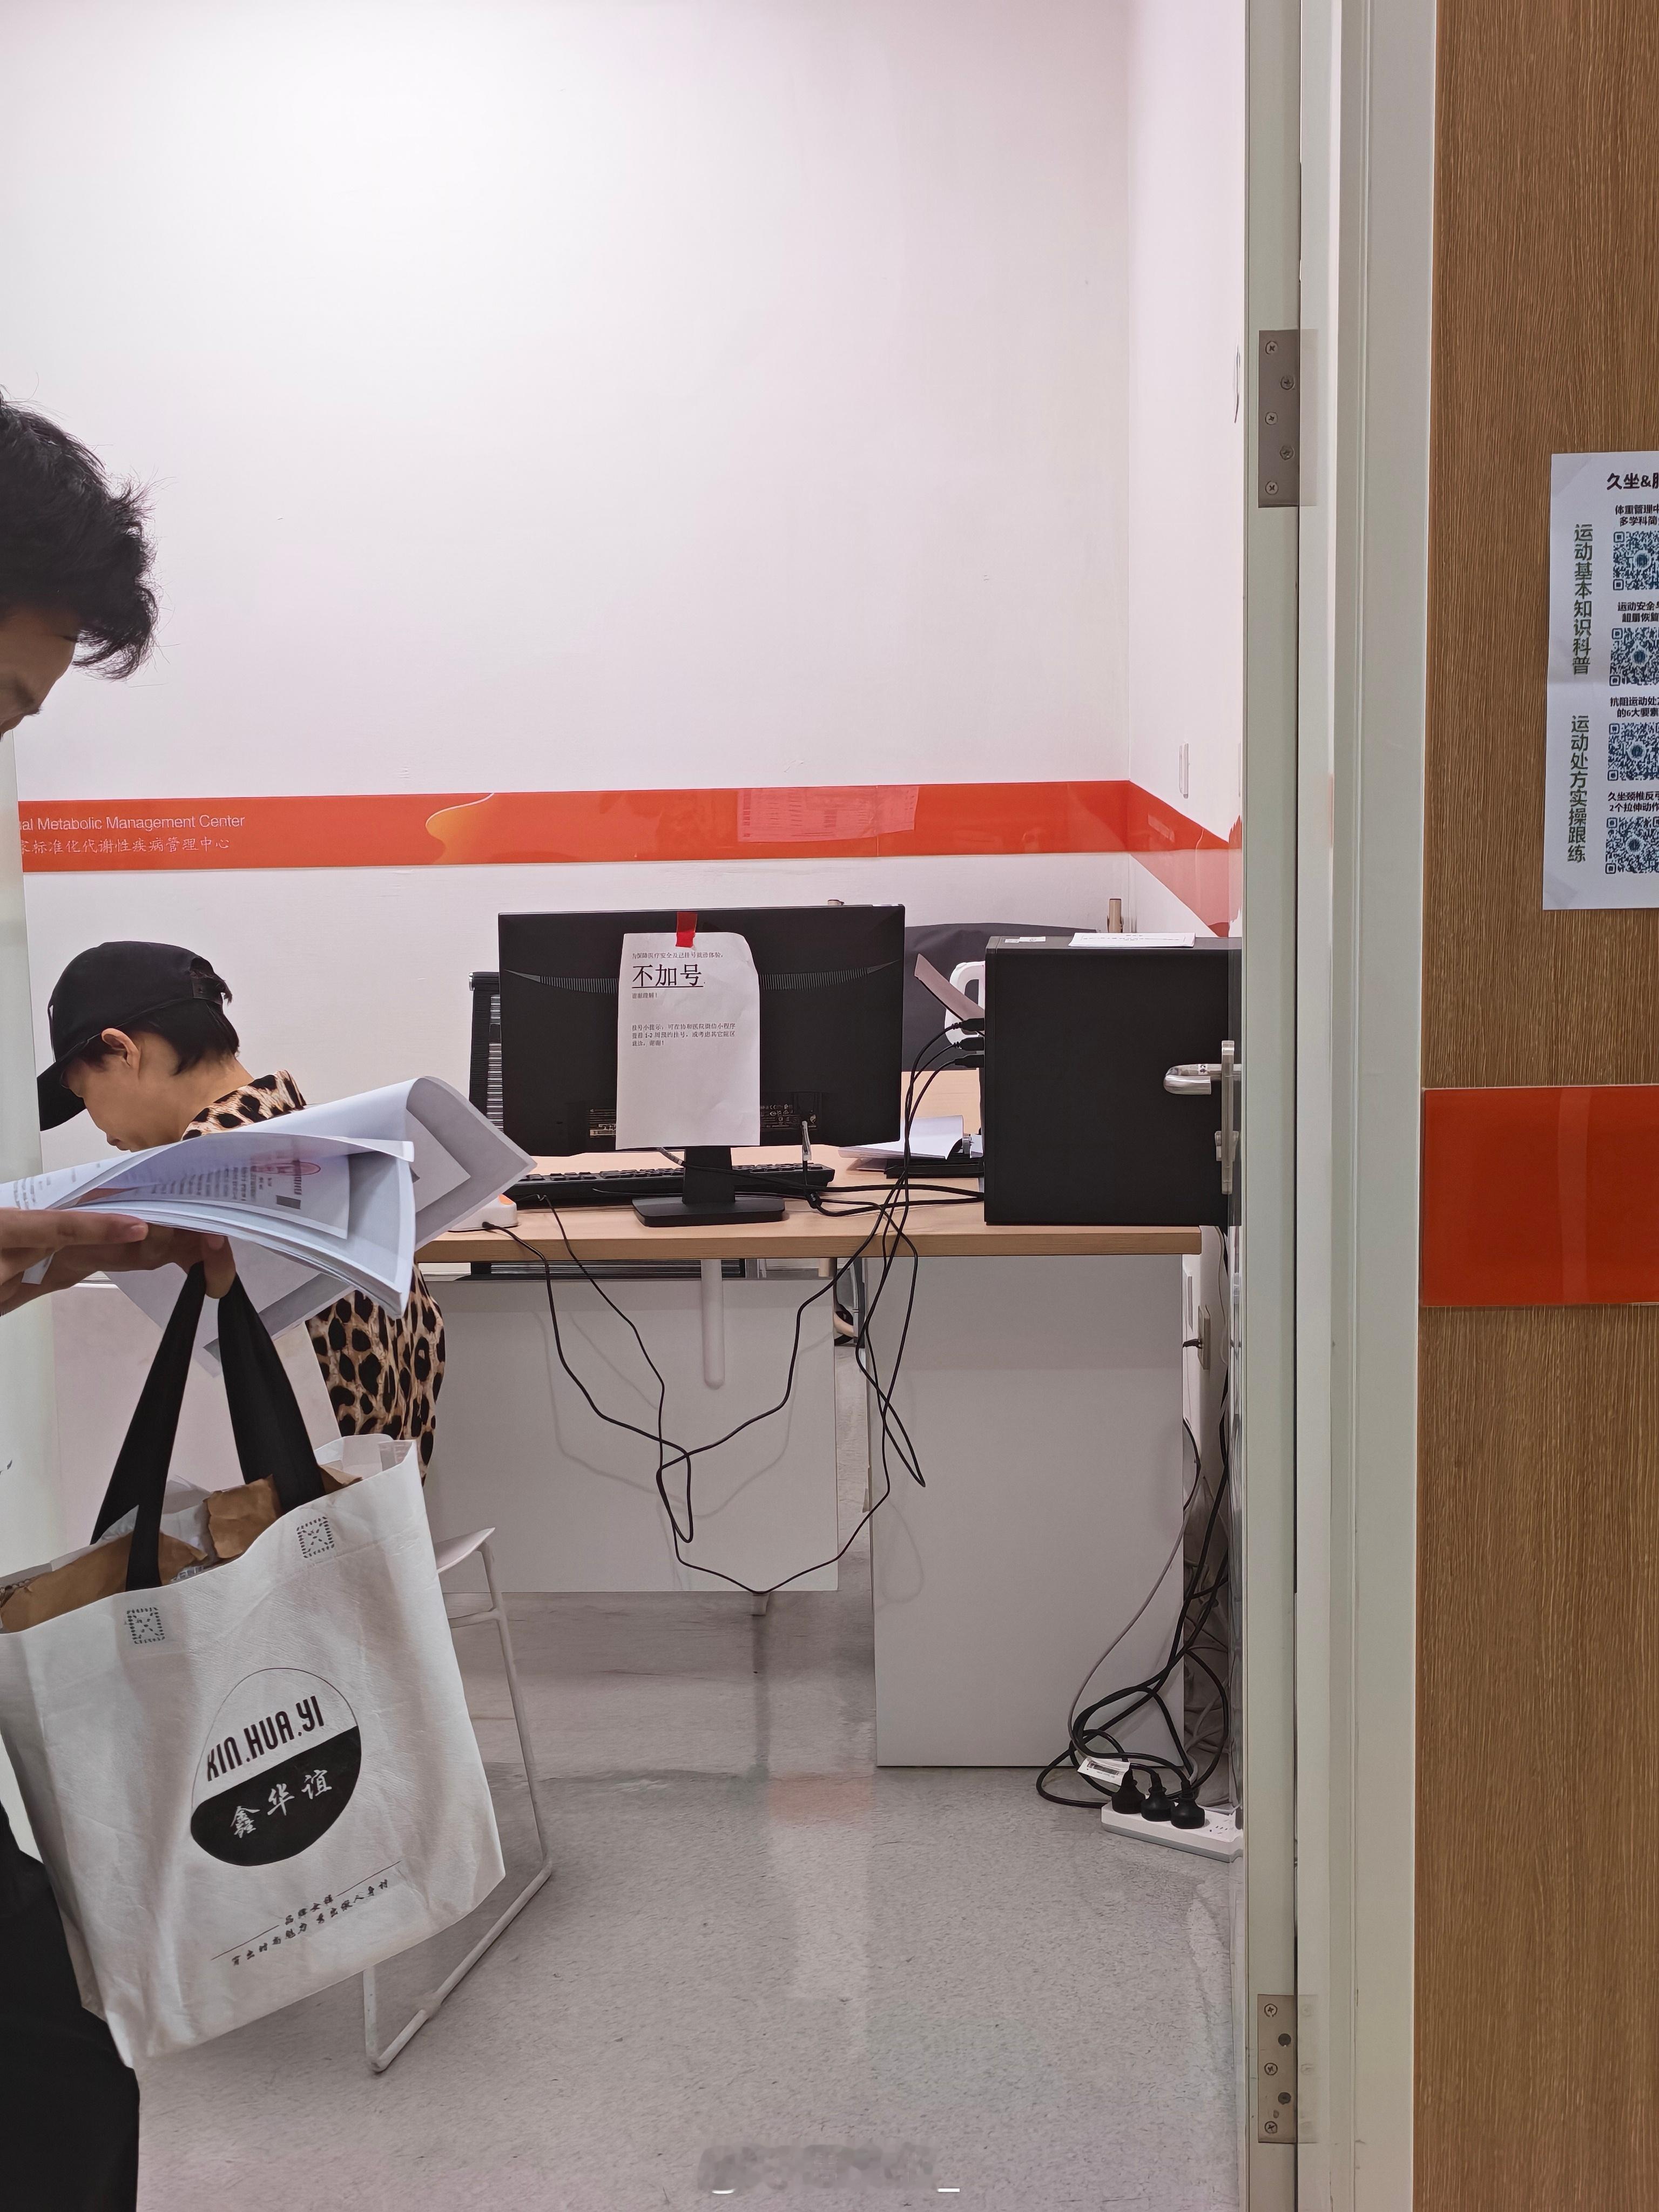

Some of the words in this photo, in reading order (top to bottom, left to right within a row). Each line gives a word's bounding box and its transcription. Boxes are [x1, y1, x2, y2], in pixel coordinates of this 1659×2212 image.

[1572, 524, 1593, 675] 运动基本知识科普
[37, 817, 103, 831] Metabolic
[106, 814, 195, 832] Management
[199, 814, 245, 828] Center
[1567, 716, 1589, 863] 运动处方实操跟练
[230, 1769, 333, 1838] 鑫华谊
